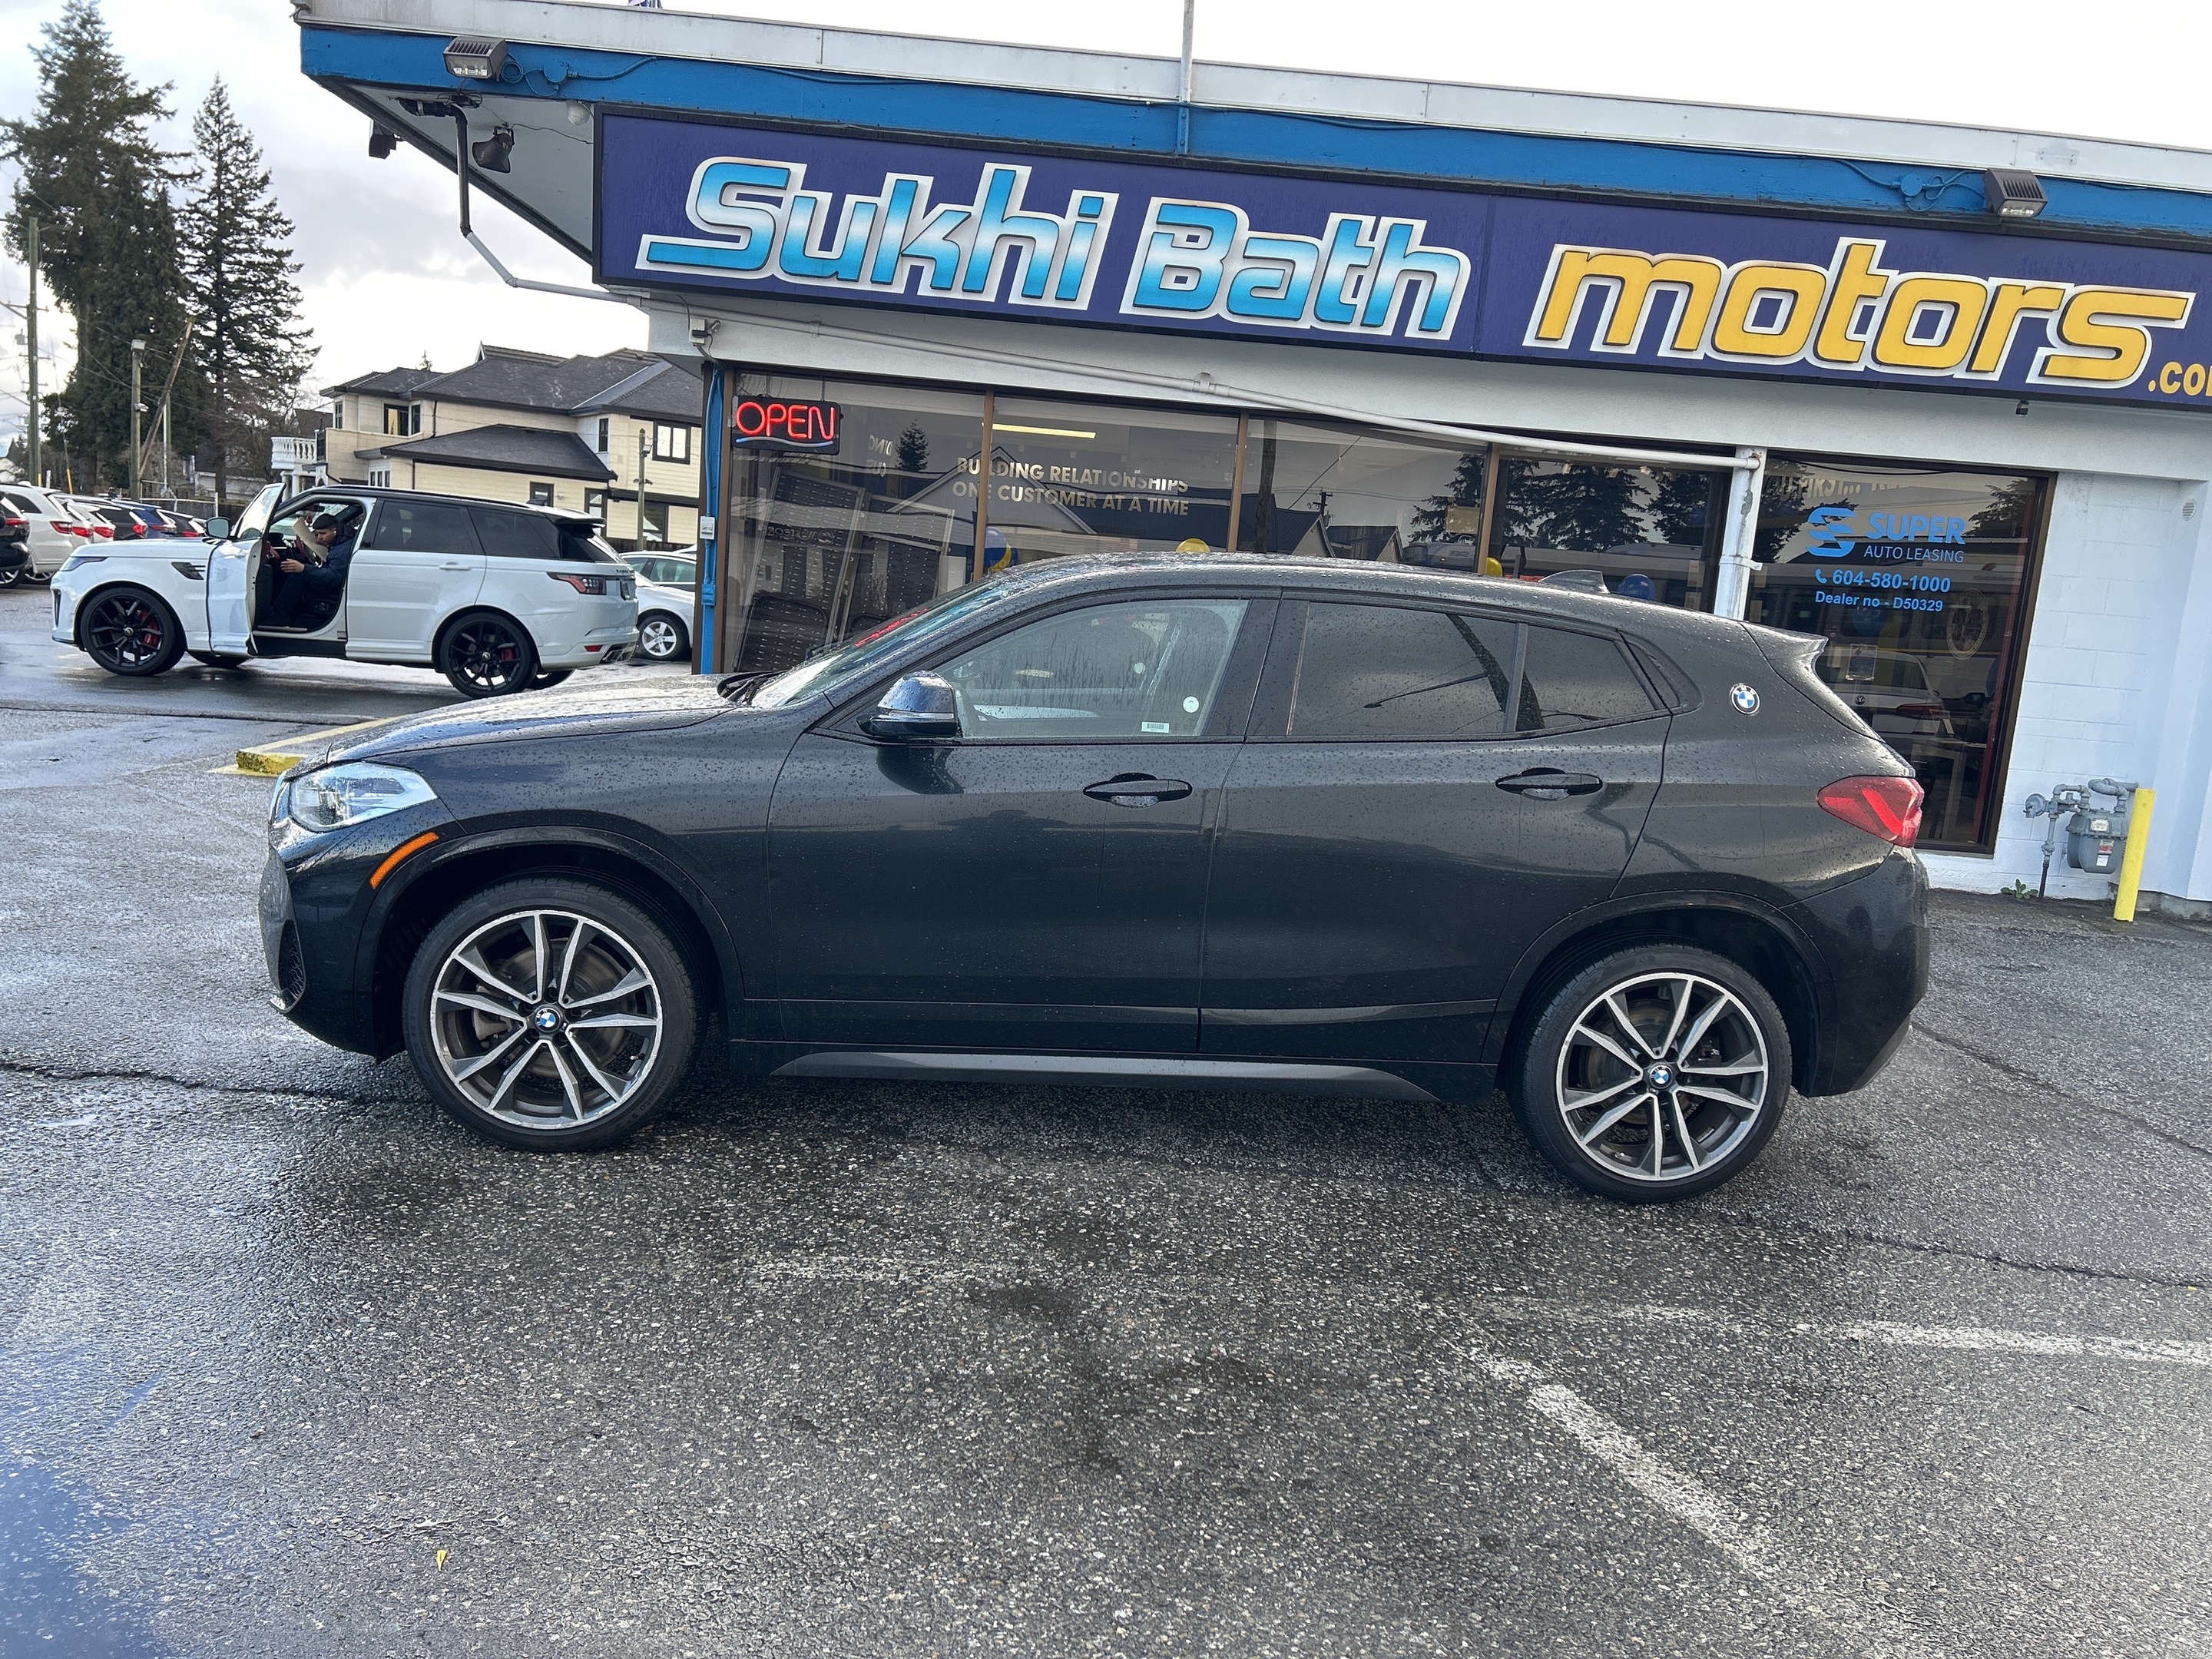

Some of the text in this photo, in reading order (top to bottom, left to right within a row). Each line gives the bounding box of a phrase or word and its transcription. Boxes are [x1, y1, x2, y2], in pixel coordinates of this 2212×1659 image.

[635, 156, 2197, 388] Sukhi Bath motors
[736, 402, 836, 440] OPEN
[958, 457, 1189, 493] BULDING RELATIONSHIPS
[998, 485, 1097, 508] CUSTOMER
[1102, 494, 1124, 511] AT
[1128, 496, 1142, 512] A
[1147, 498, 1189, 516] TIME
[1865, 512, 1966, 545] SUPER
[1863, 545, 1965, 563] AUTO LEASING
[1832, 569, 1952, 593] 604-580-1000
[1815, 591, 1860, 606] Dealer
[1863, 598, 1881, 607] no
[1892, 598, 1944, 612] D50329
